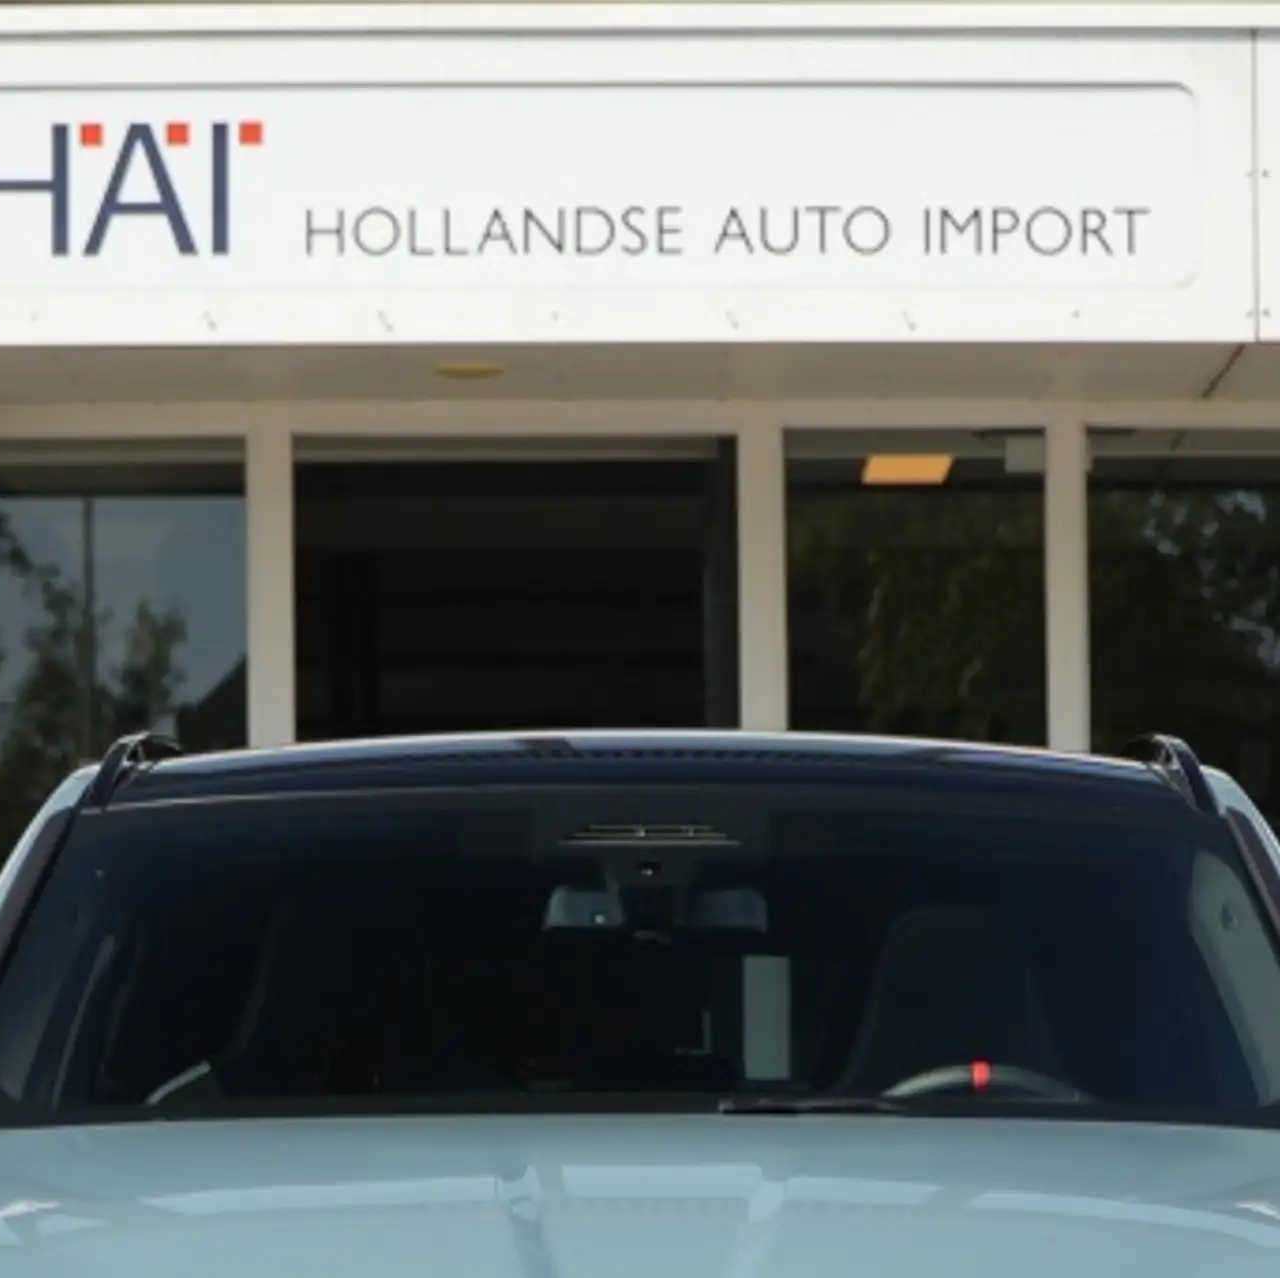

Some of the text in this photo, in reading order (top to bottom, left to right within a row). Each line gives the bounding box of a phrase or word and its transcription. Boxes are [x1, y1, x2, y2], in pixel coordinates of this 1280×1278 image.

[306, 206, 1148, 256] HOLLANDSE AUTO IMPORT
